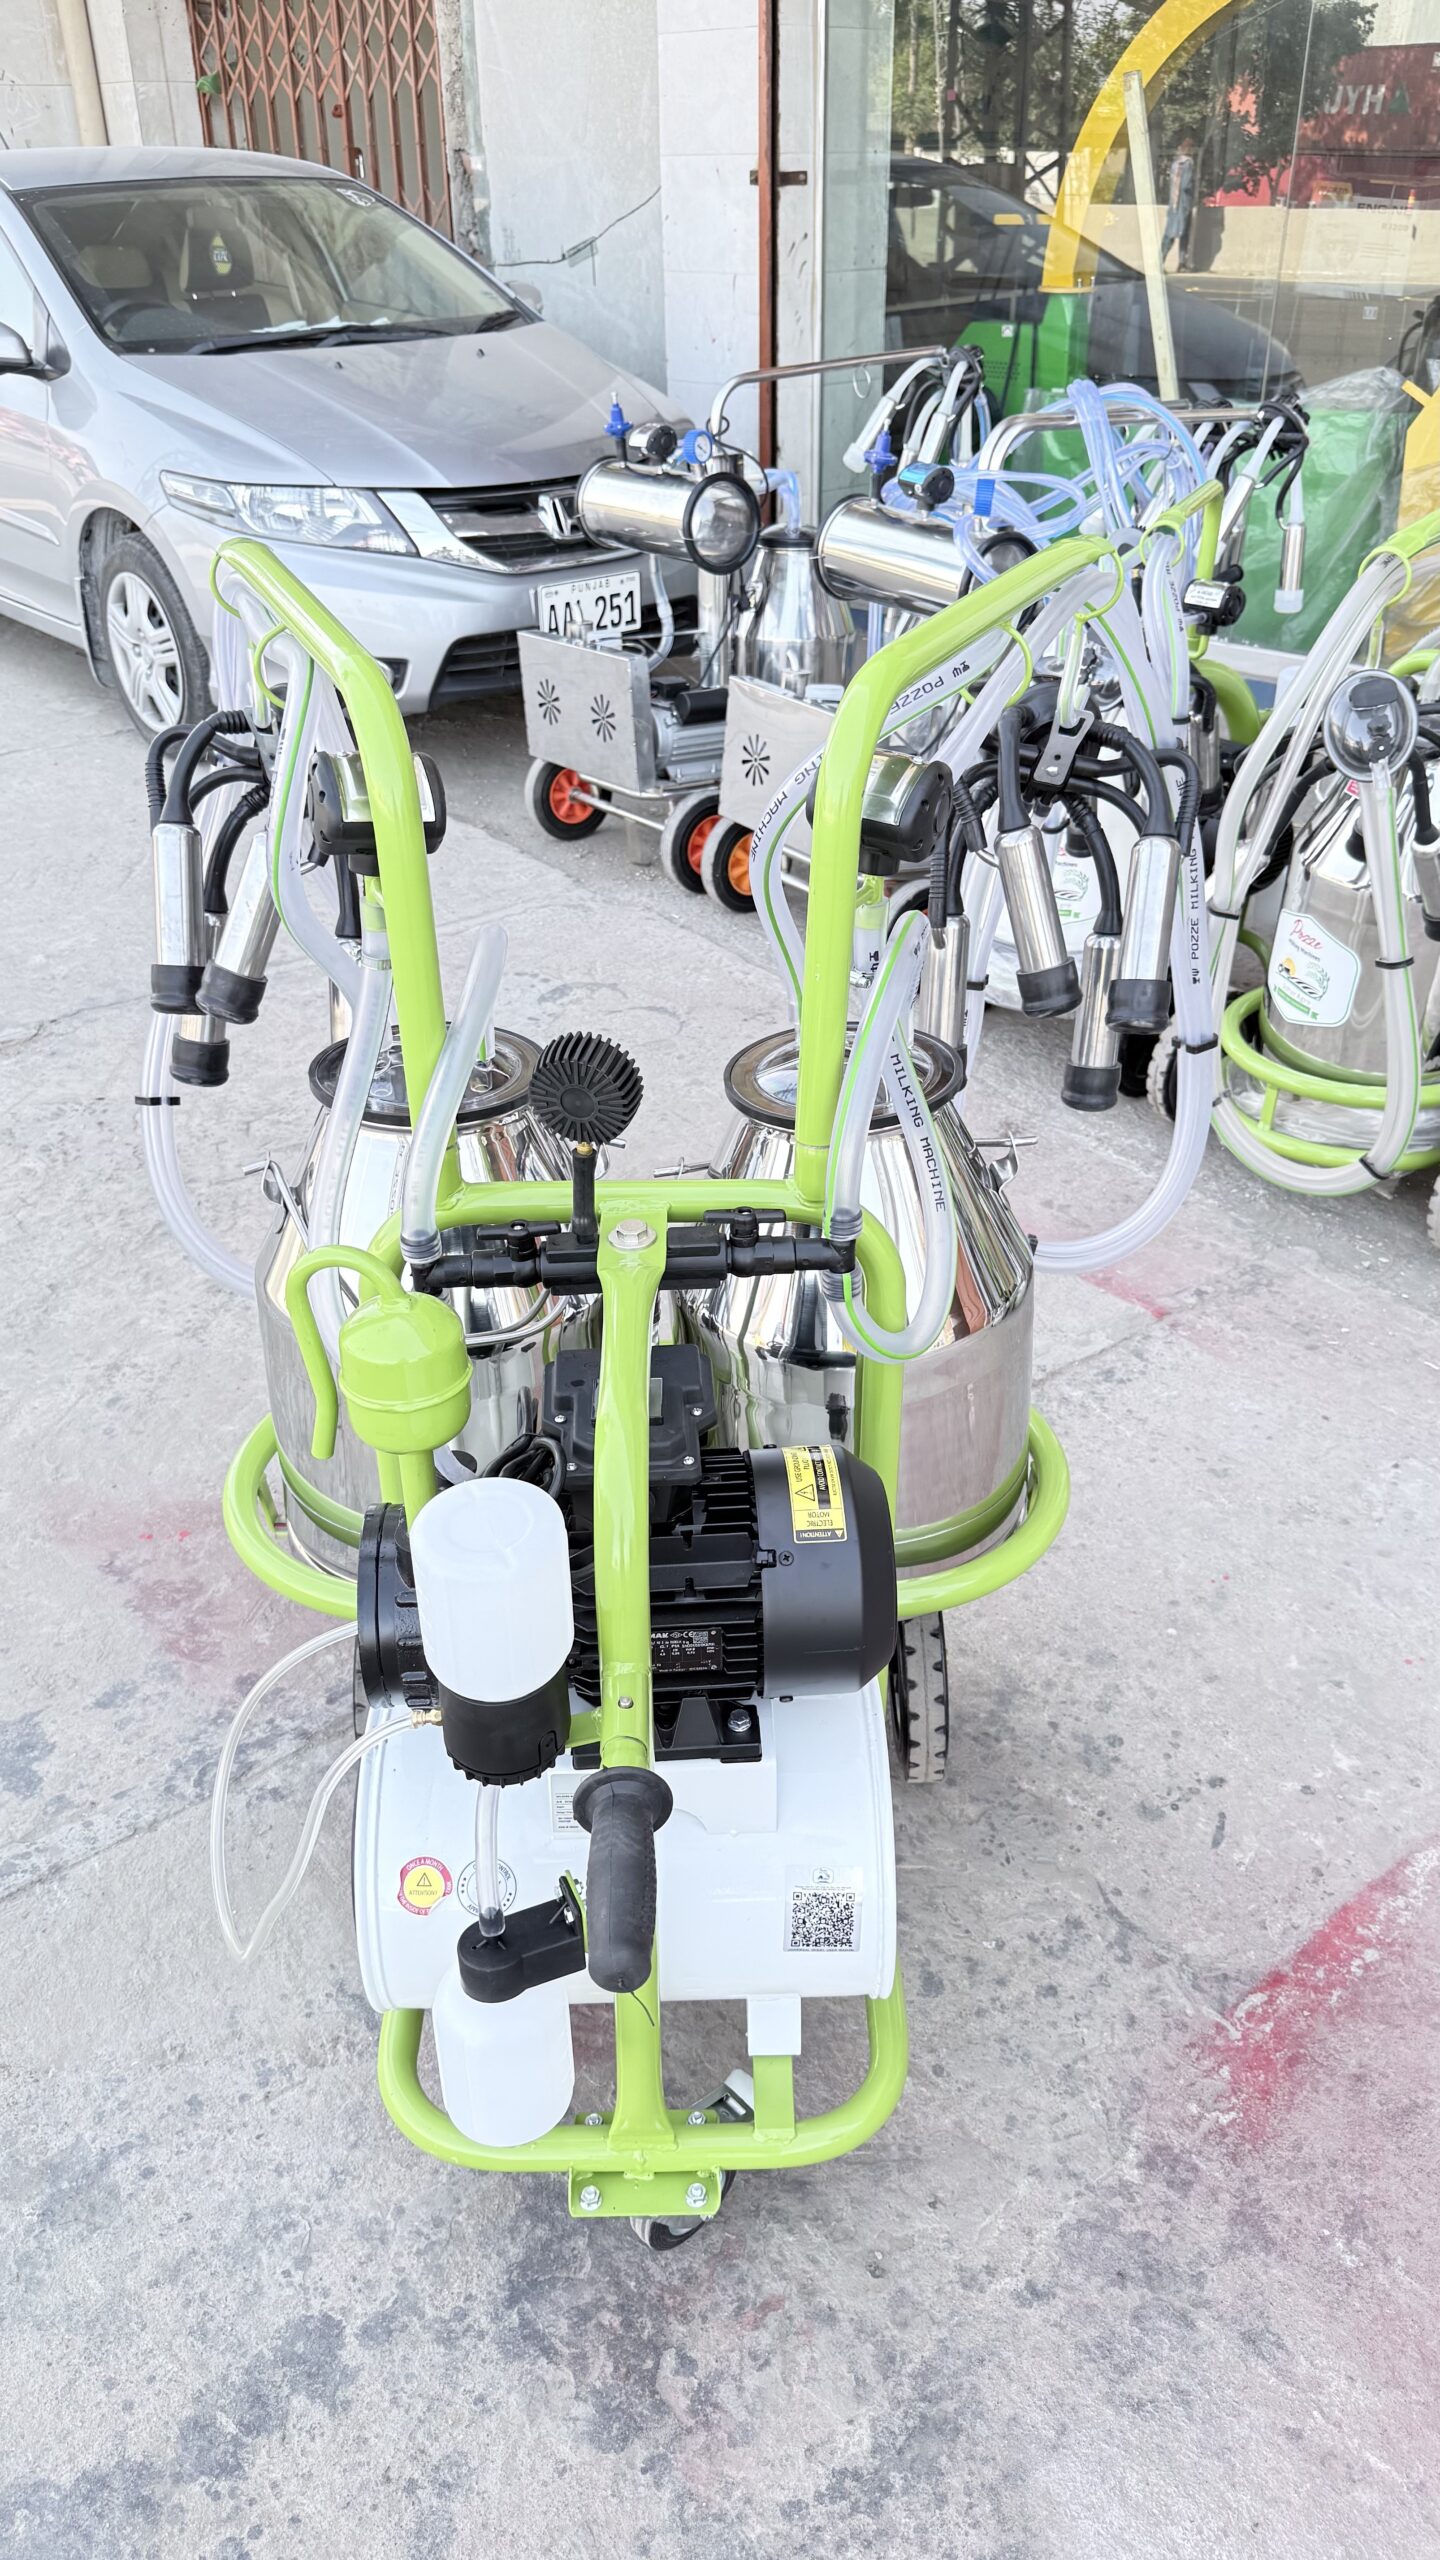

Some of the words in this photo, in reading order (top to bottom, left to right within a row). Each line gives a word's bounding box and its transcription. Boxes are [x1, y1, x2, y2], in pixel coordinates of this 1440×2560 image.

[571, 578, 610, 593] PUNJAB
[595, 590, 637, 631] 251
[752, 792, 788, 862] MACHINE
[1190, 848, 1199, 910] MILKING
[1191, 917, 1199, 960] POZZE
[890, 1053, 924, 1128] MILKING
[920, 1136, 946, 1213] MACHINE
[407, 1859, 421, 1871] ONCE
[425, 1859, 443, 1871] MONTH
